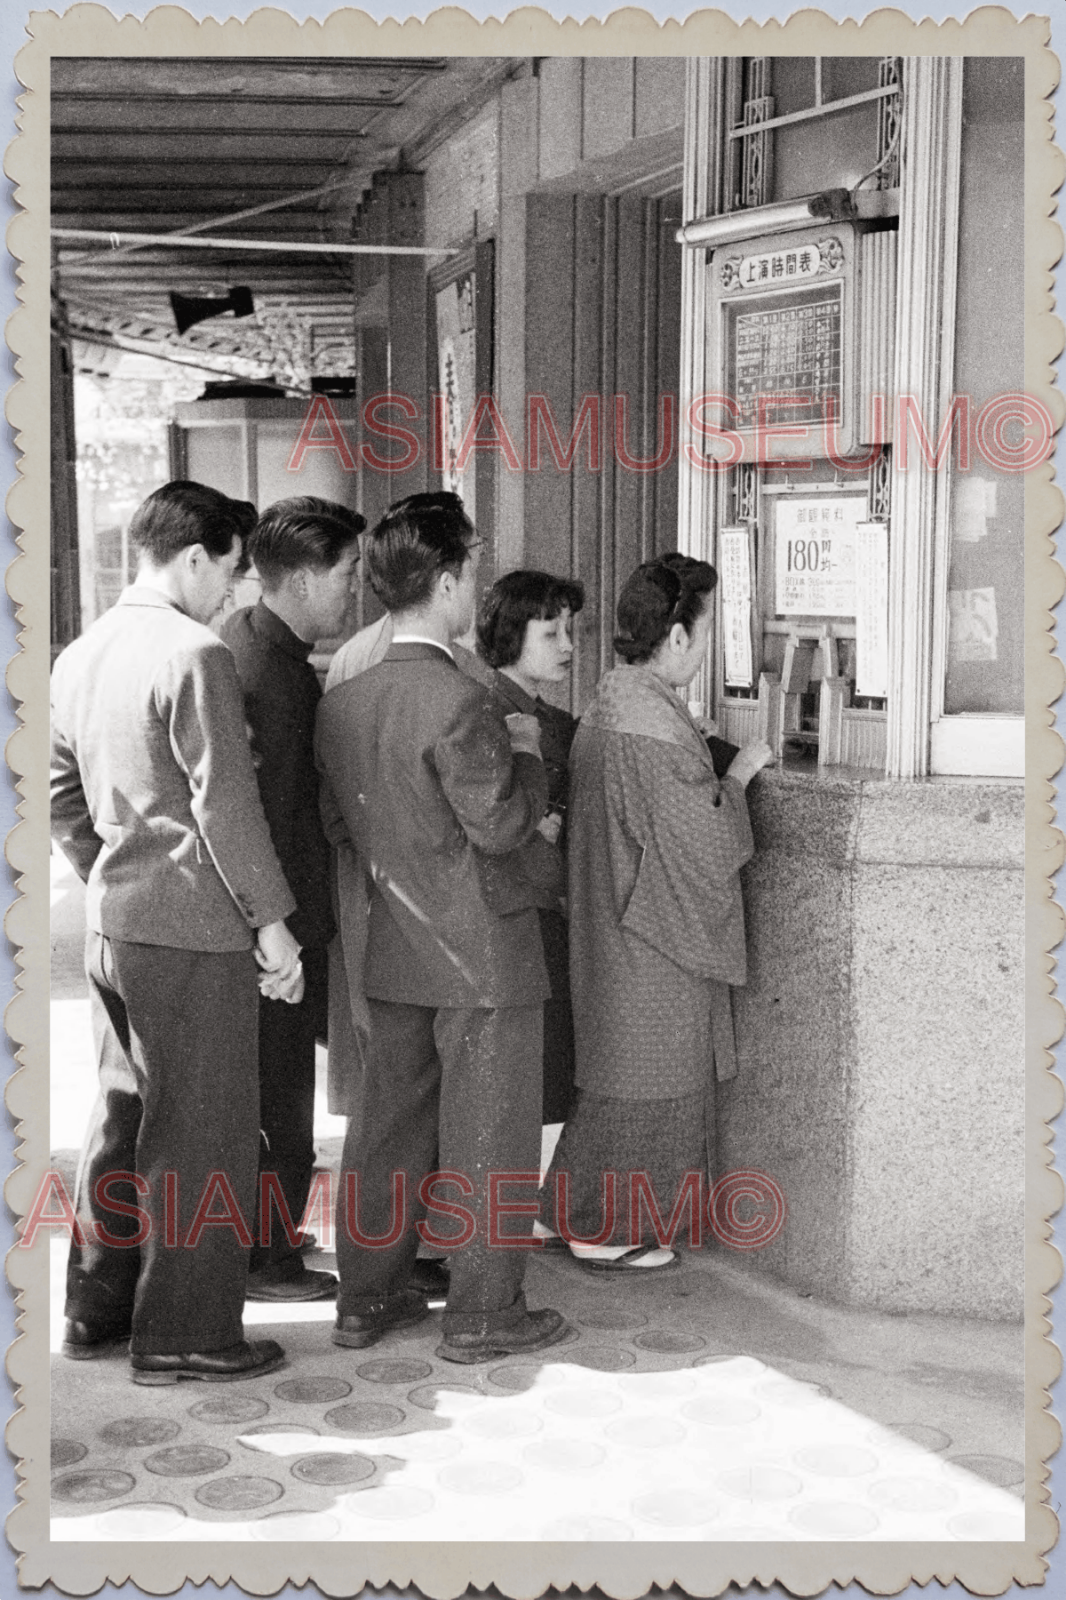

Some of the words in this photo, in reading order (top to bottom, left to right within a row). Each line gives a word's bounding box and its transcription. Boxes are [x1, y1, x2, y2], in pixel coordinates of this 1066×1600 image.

[746, 250, 812, 283] 上演時間表
[787, 539, 820, 573] 180
